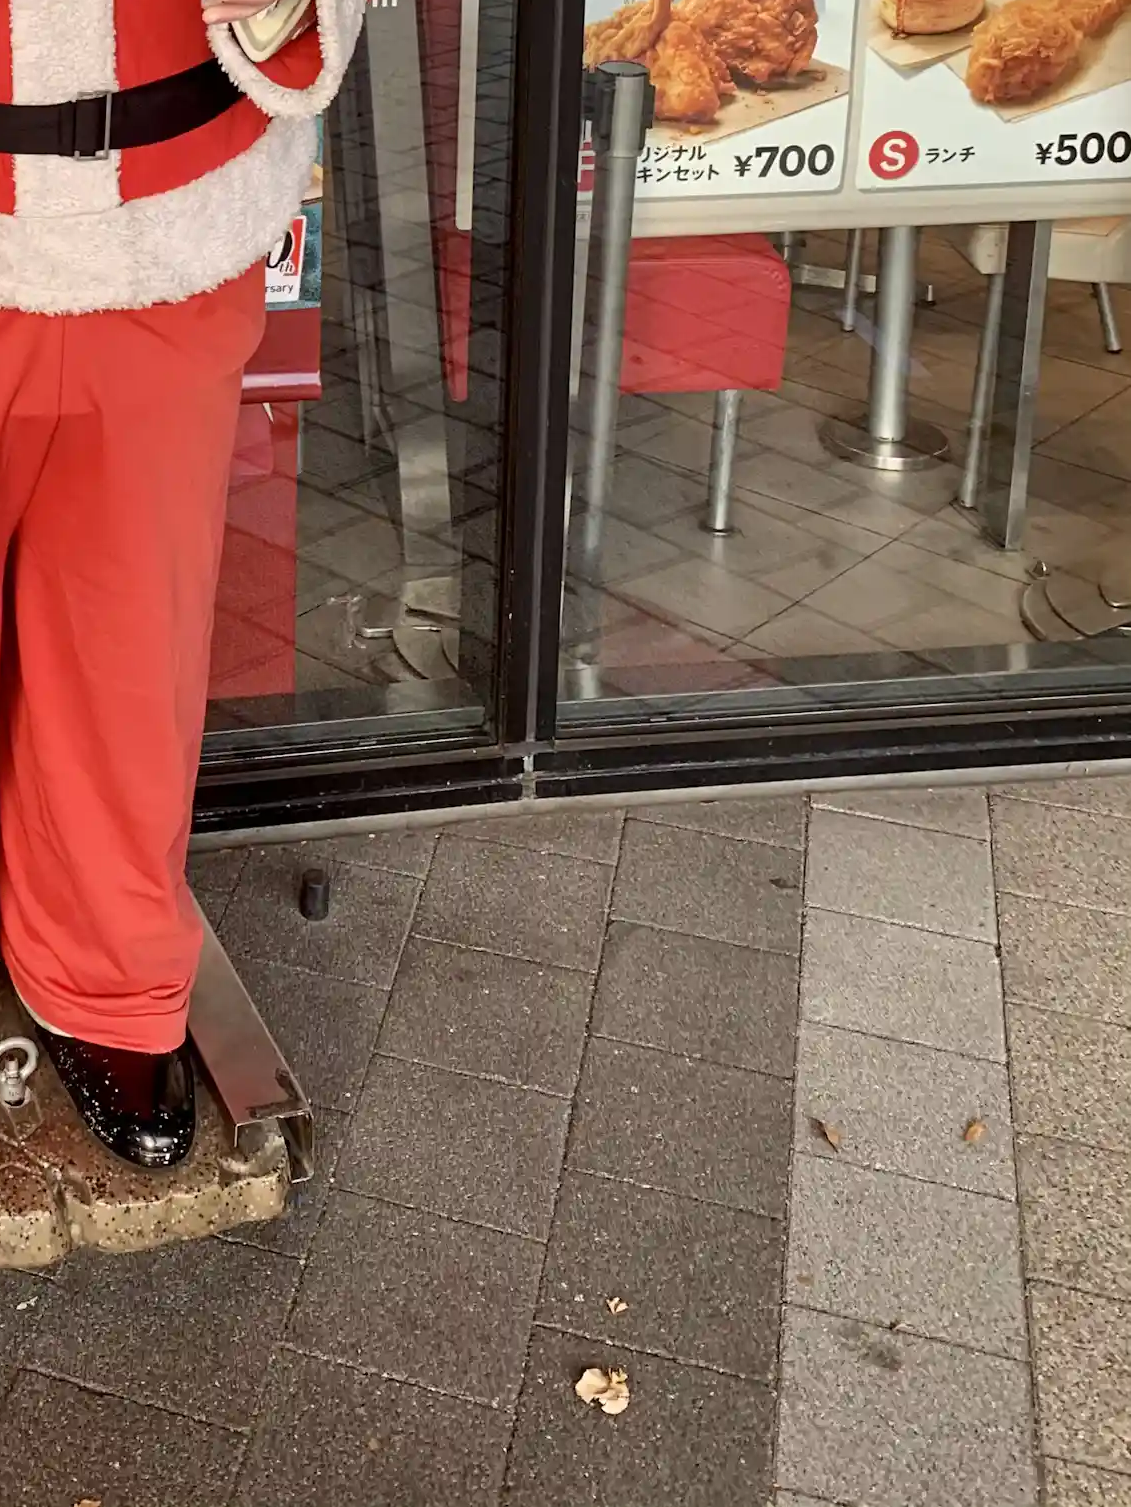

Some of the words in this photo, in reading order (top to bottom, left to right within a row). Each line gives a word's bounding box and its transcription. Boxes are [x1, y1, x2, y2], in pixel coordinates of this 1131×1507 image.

[734, 144, 835, 178] ¥700
[880, 138, 908, 172] S
[925, 146, 976, 164] ランチ
[1035, 131, 1131, 166] ¥500
